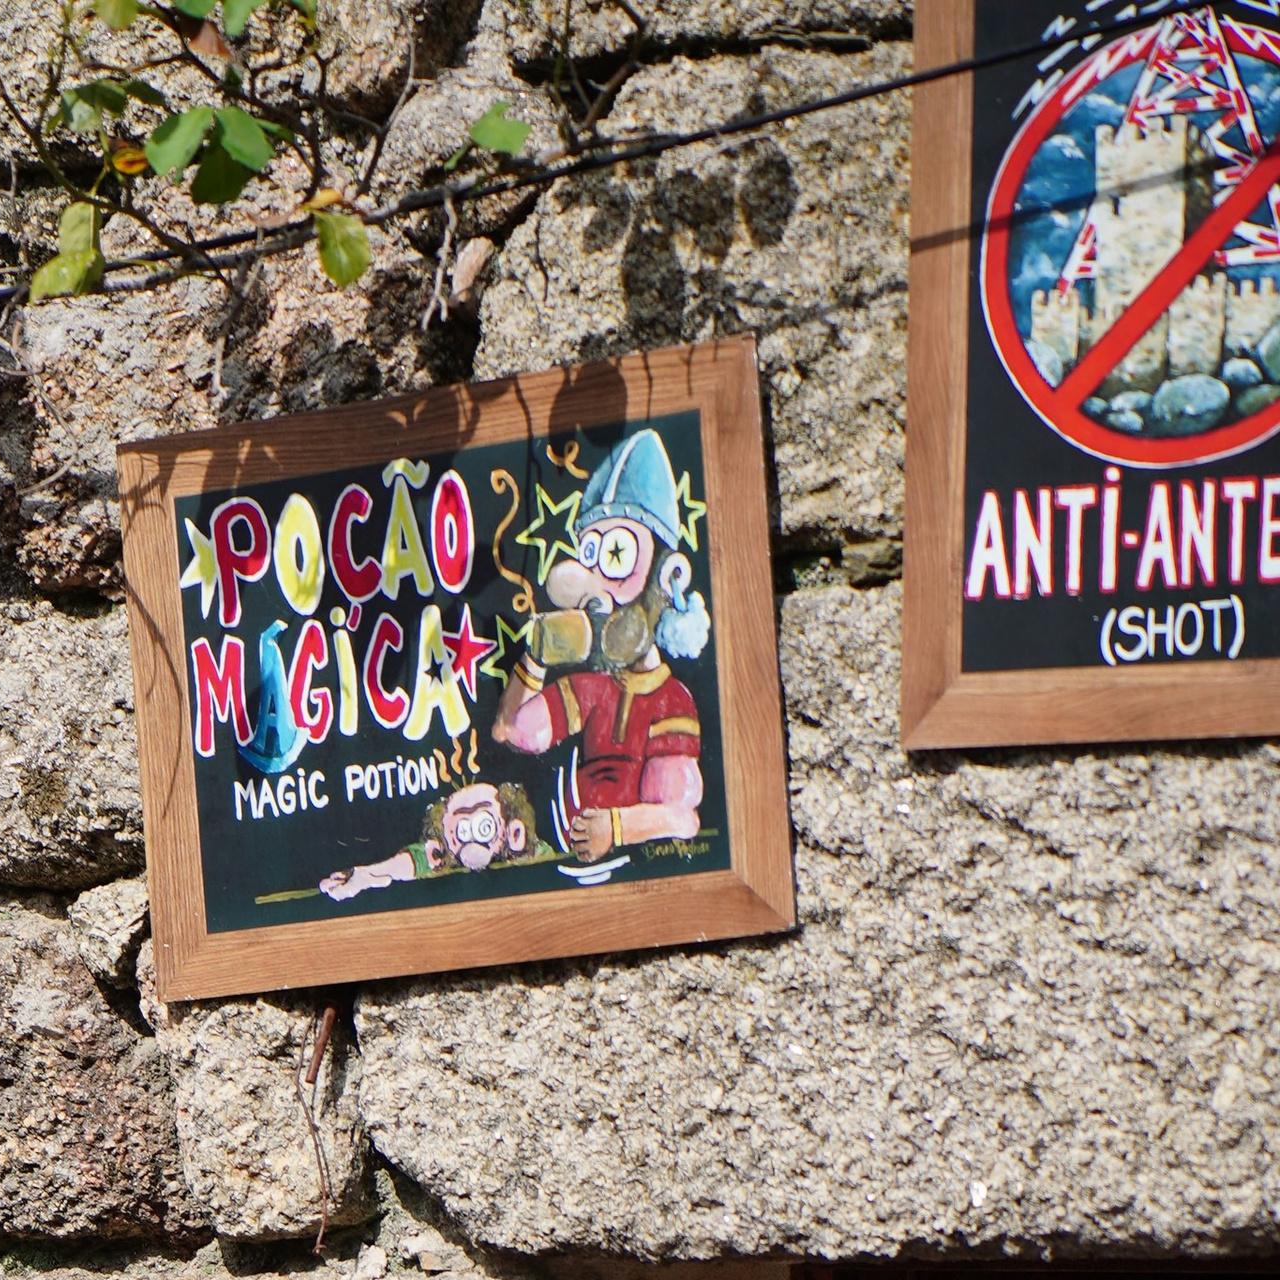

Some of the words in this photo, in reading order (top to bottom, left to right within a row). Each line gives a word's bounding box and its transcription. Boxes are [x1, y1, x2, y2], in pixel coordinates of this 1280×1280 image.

[209, 458, 475, 628] POÇÃO
[1099, 594, 1246, 666] (SHOT)
[233, 768, 329, 820] MAGIC
[344, 754, 440, 803] POTION
